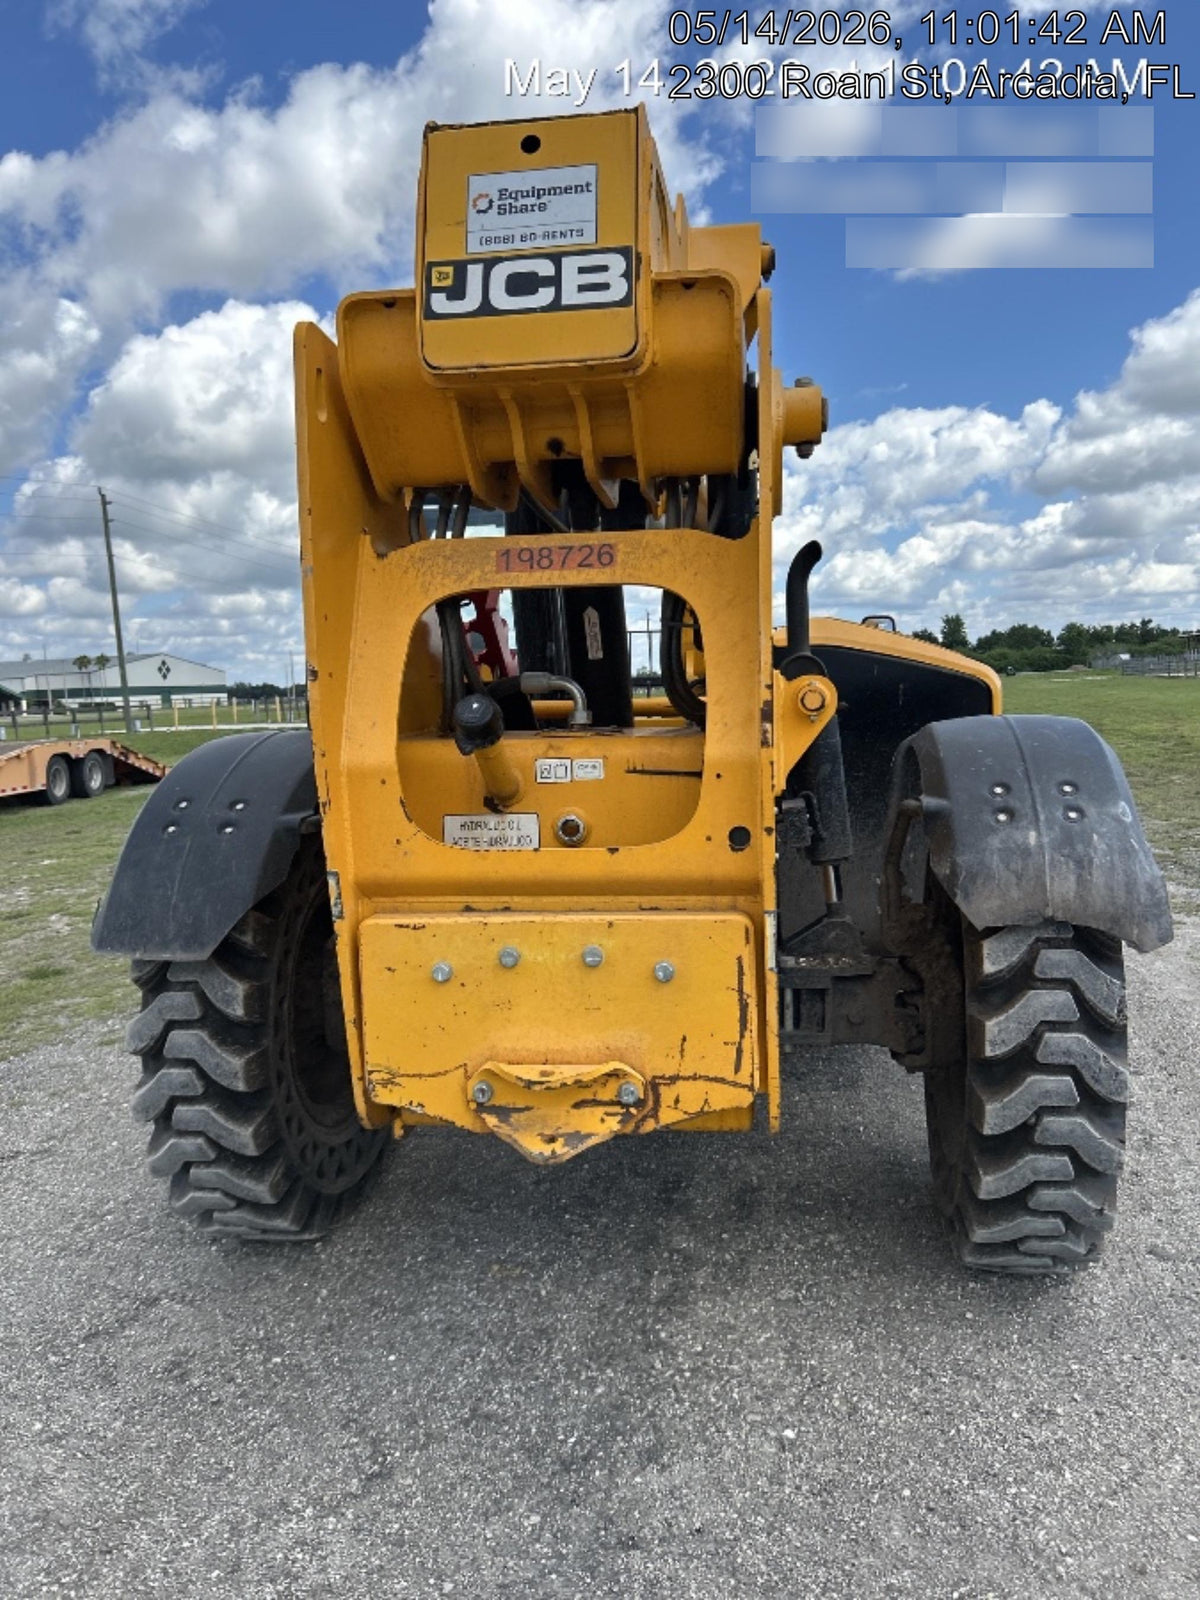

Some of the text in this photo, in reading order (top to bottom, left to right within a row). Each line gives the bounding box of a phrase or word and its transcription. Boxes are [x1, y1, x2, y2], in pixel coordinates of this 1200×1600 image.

[497, 181, 593, 203] Equipment
[497, 201, 548, 216] Share
[429, 252, 629, 315] JCB
[500, 543, 615, 572] 198726
